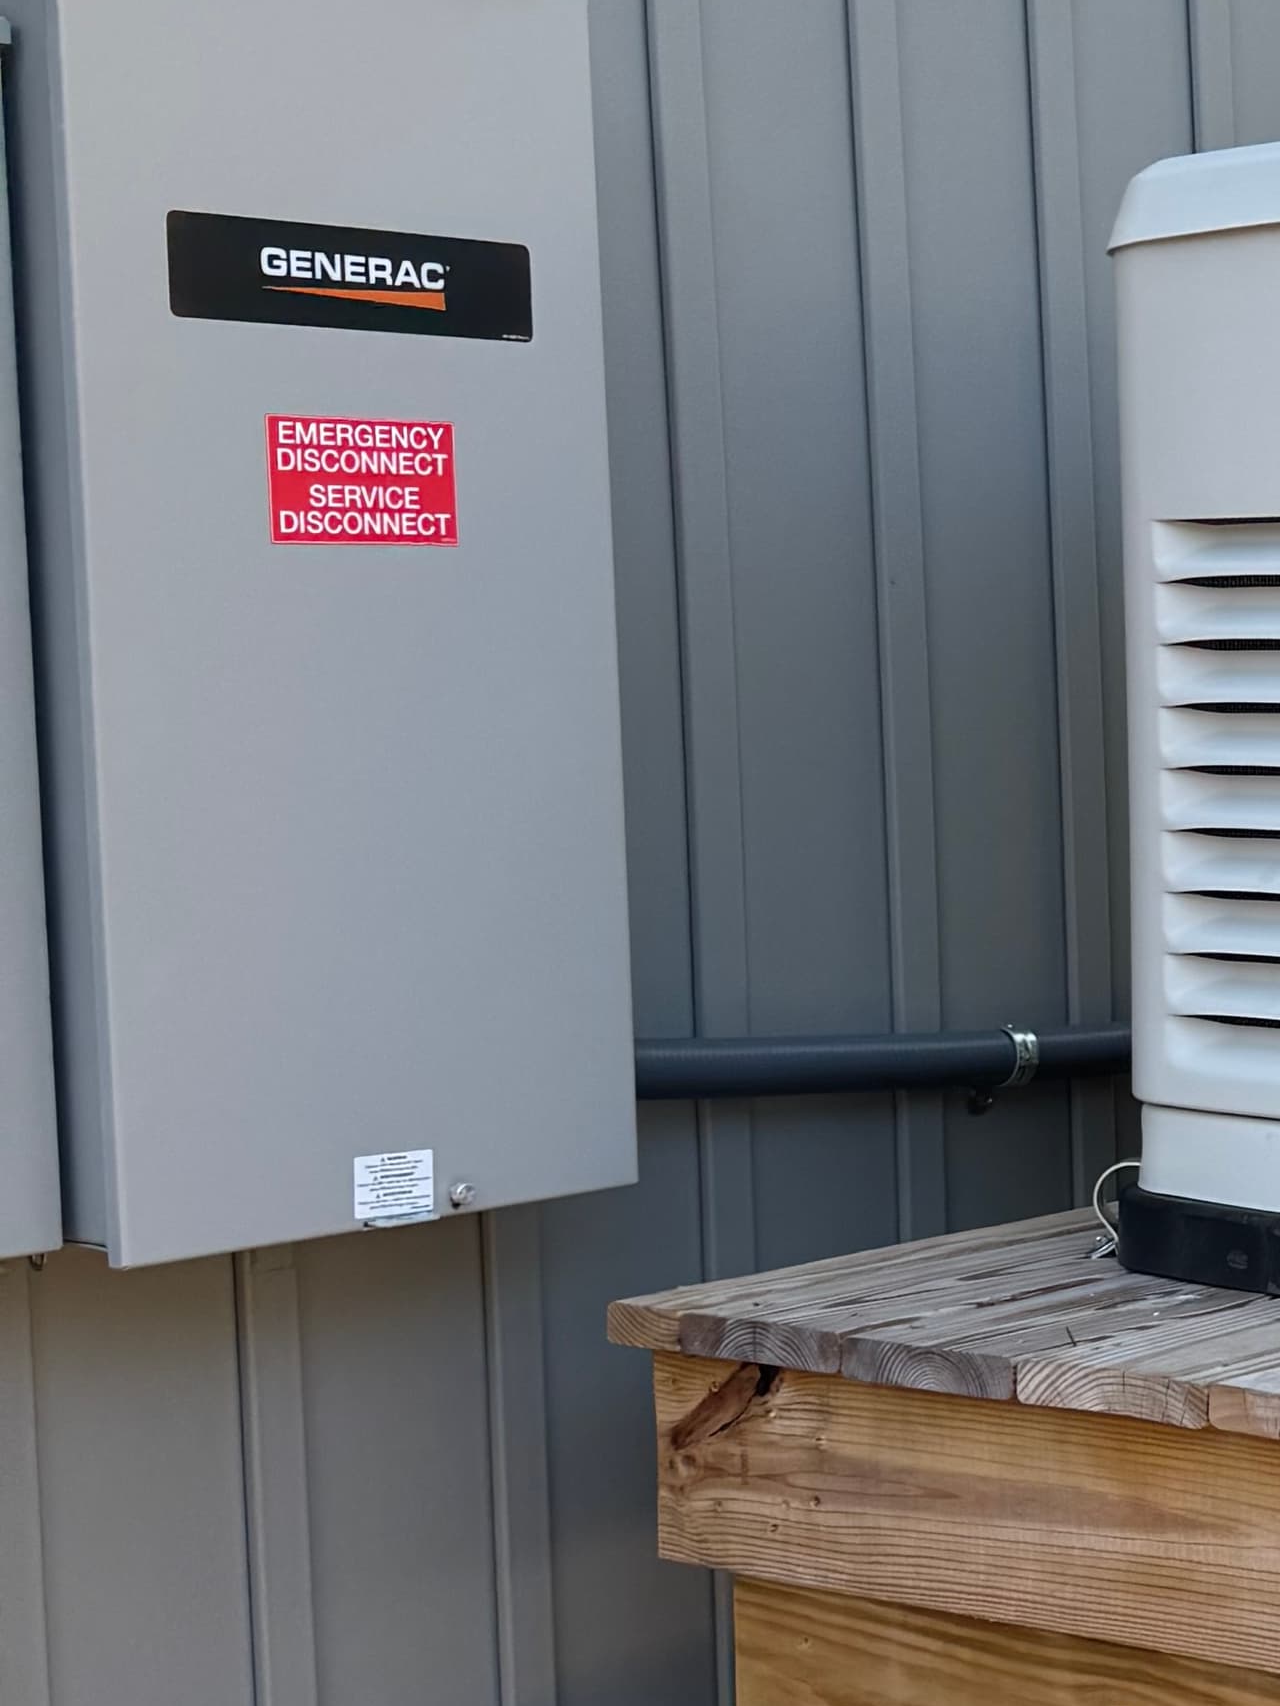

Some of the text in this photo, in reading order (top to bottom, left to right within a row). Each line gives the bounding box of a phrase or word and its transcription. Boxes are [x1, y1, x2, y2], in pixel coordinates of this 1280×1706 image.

[260, 246, 445, 290] GENERAC
[278, 421, 443, 450] EMERGENCY
[277, 448, 448, 476] DISCONNECT
[309, 484, 420, 510] SERVICE
[279, 510, 451, 536] DISCONNECT
